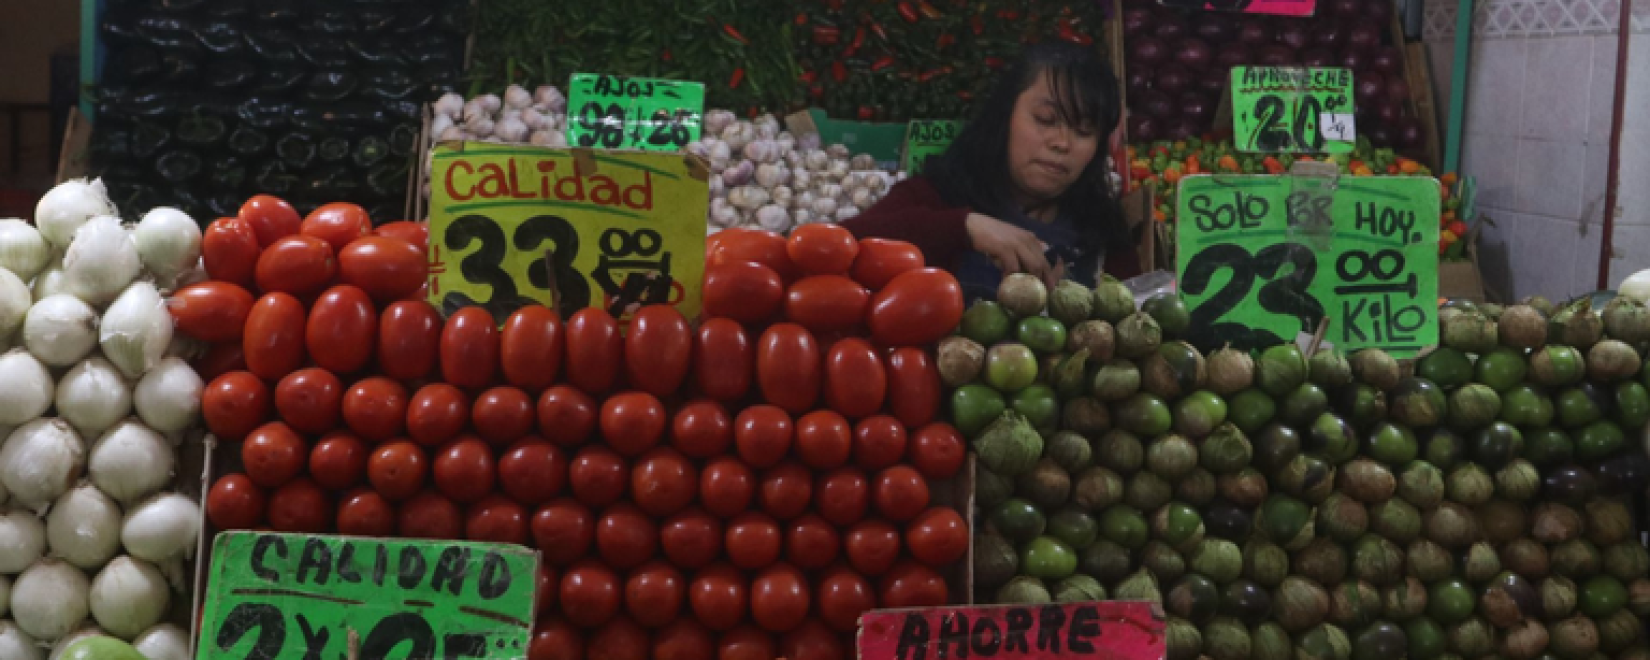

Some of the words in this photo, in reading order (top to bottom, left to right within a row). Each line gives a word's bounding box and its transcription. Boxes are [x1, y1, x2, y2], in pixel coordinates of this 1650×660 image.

[1253, 94, 1322, 151] 20
[443, 214, 592, 322] 33
[599, 228, 663, 256] 00
[1180, 243, 1326, 350] 23
[1336, 250, 1405, 282] 00
[251, 534, 512, 600] CALIDAD
[897, 602, 1102, 660] AHORRE
